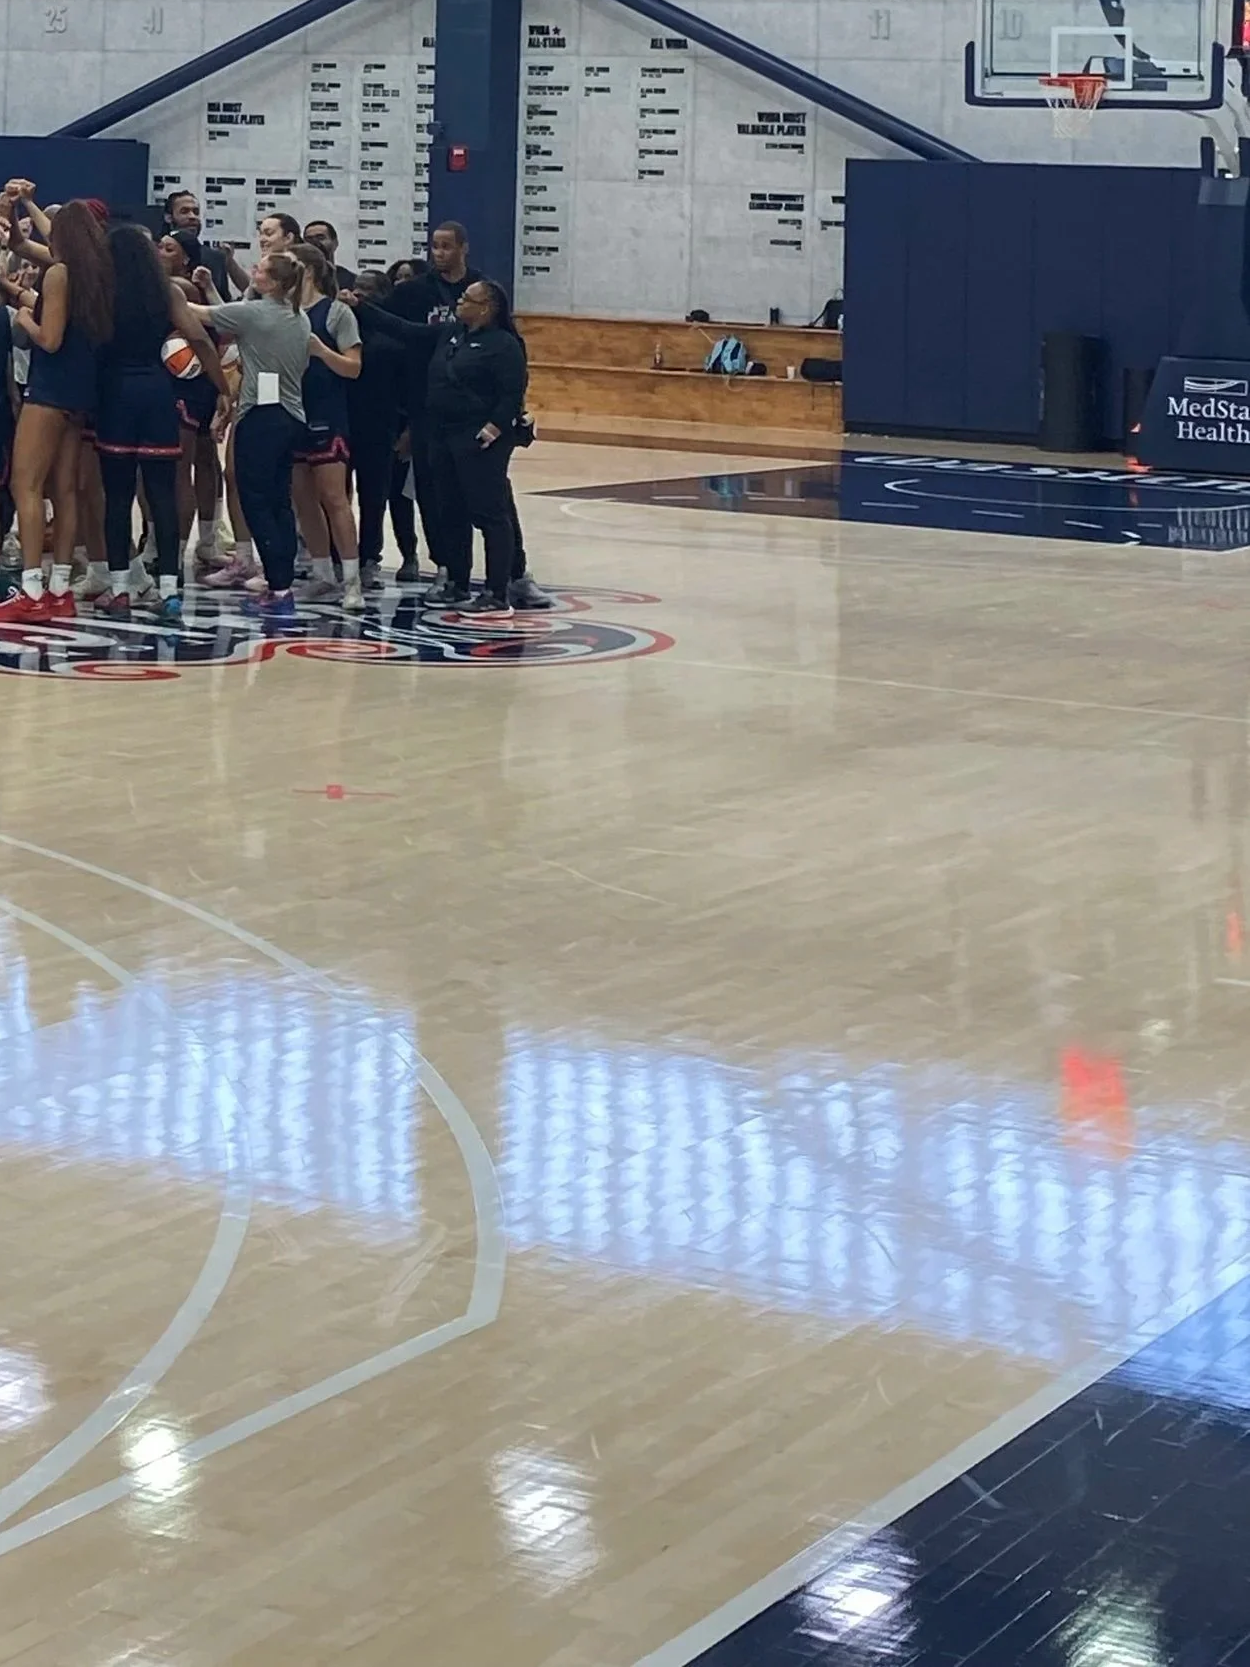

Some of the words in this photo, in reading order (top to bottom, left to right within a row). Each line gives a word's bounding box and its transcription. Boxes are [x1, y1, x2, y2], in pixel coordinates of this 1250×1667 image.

[45, 6, 70, 34] 25
[868, 9, 891, 40] 11
[1177, 421, 1250, 444] Health
